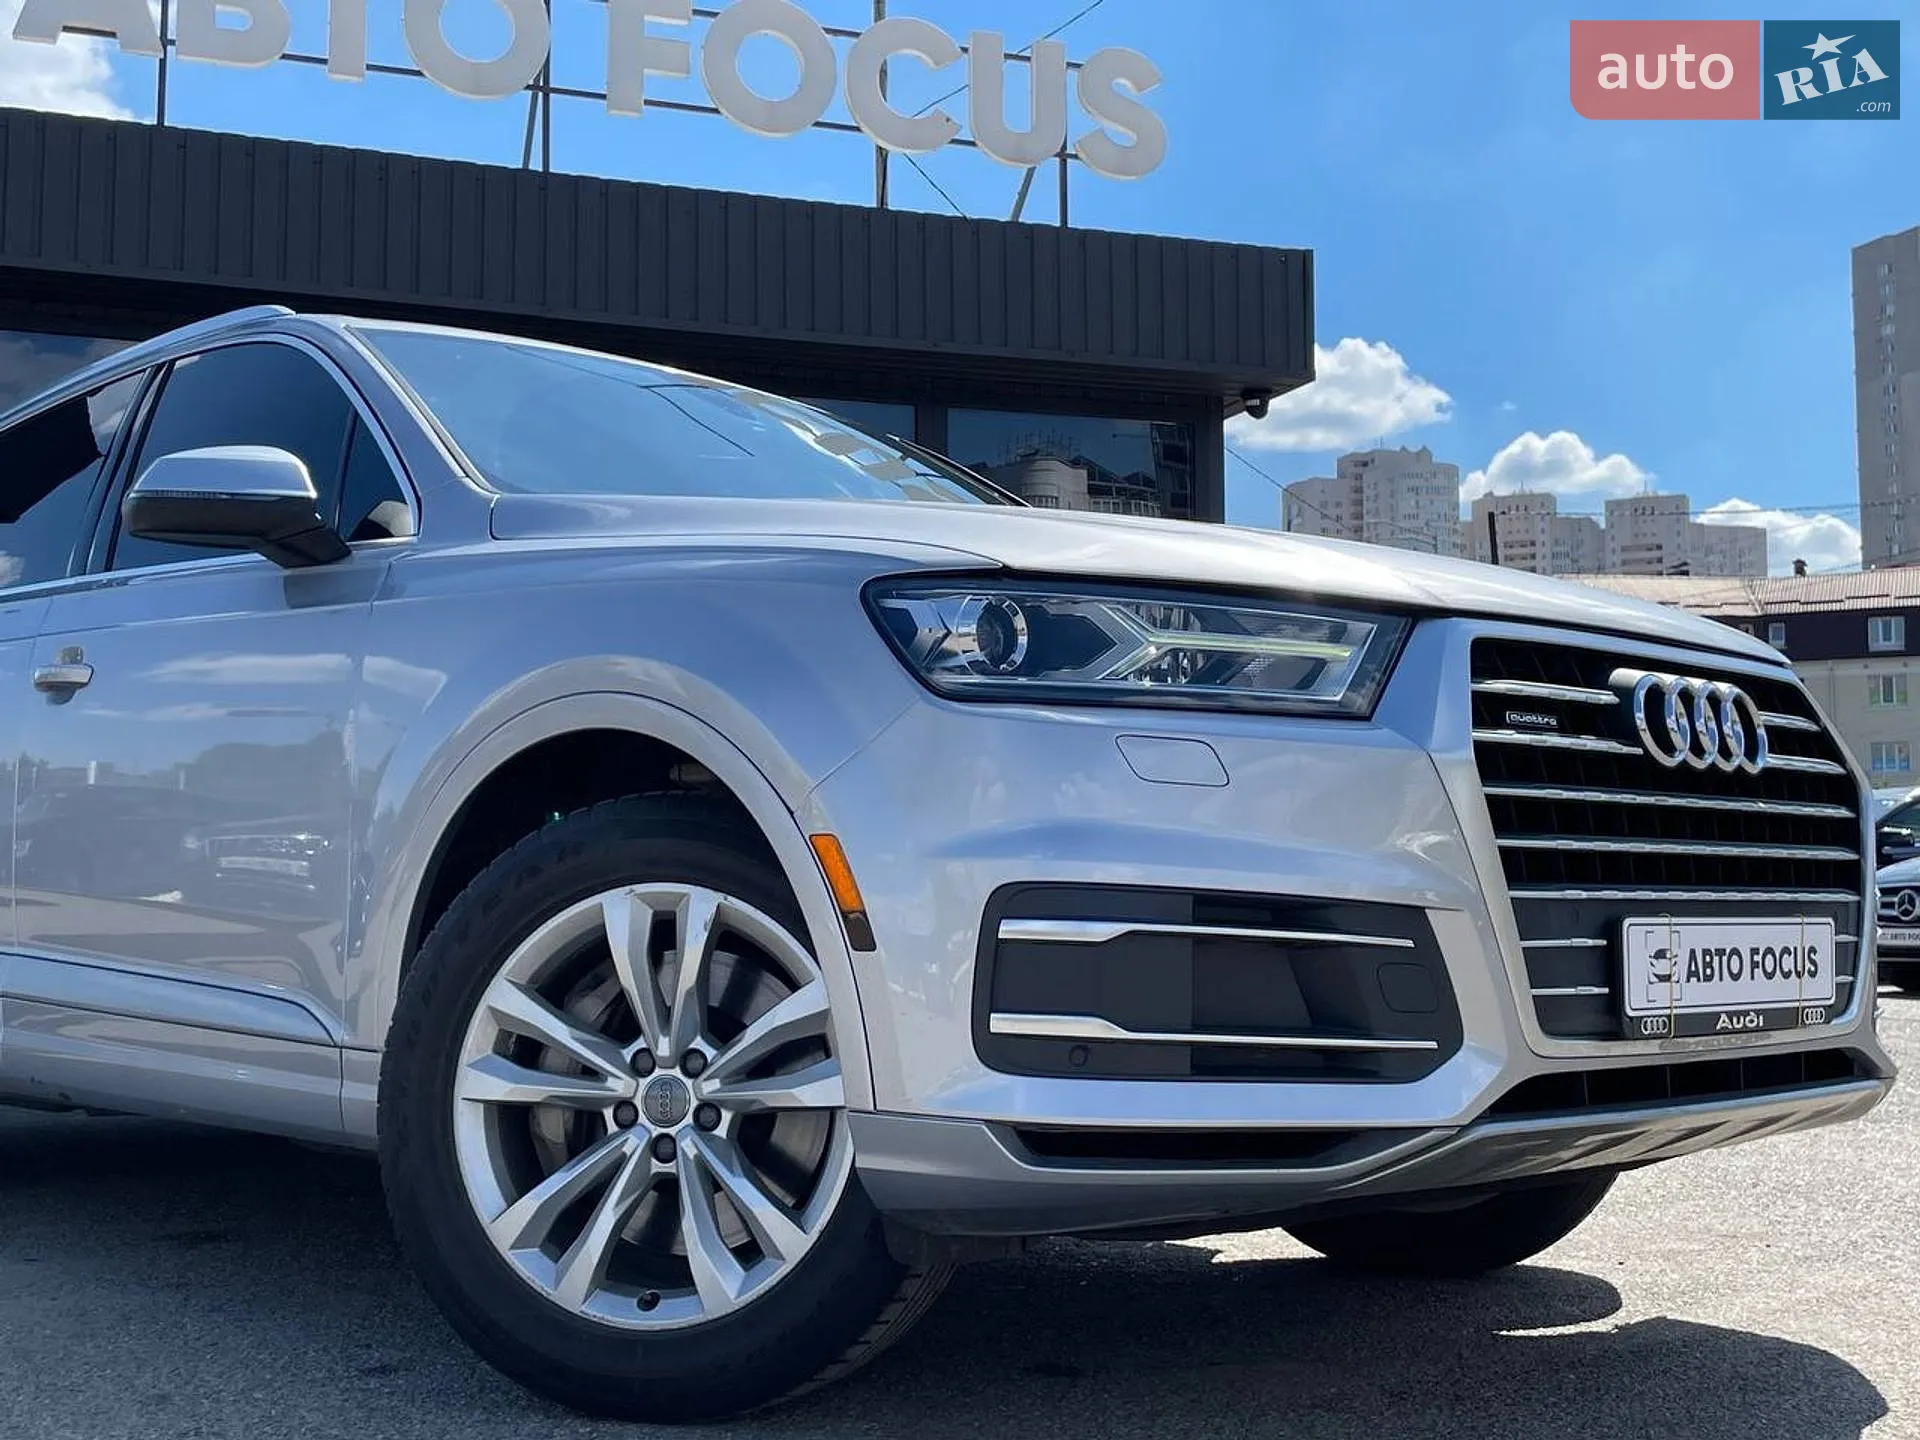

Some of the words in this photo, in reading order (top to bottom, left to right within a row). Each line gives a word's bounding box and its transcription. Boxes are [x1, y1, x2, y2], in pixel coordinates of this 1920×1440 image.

[606, 0, 1168, 179] FOCUS
[1510, 713, 1558, 726] quattro
[1685, 946, 1744, 983] АВТО
[1749, 944, 1819, 980] FOCUS
[1715, 1011, 1764, 1030] Audi
